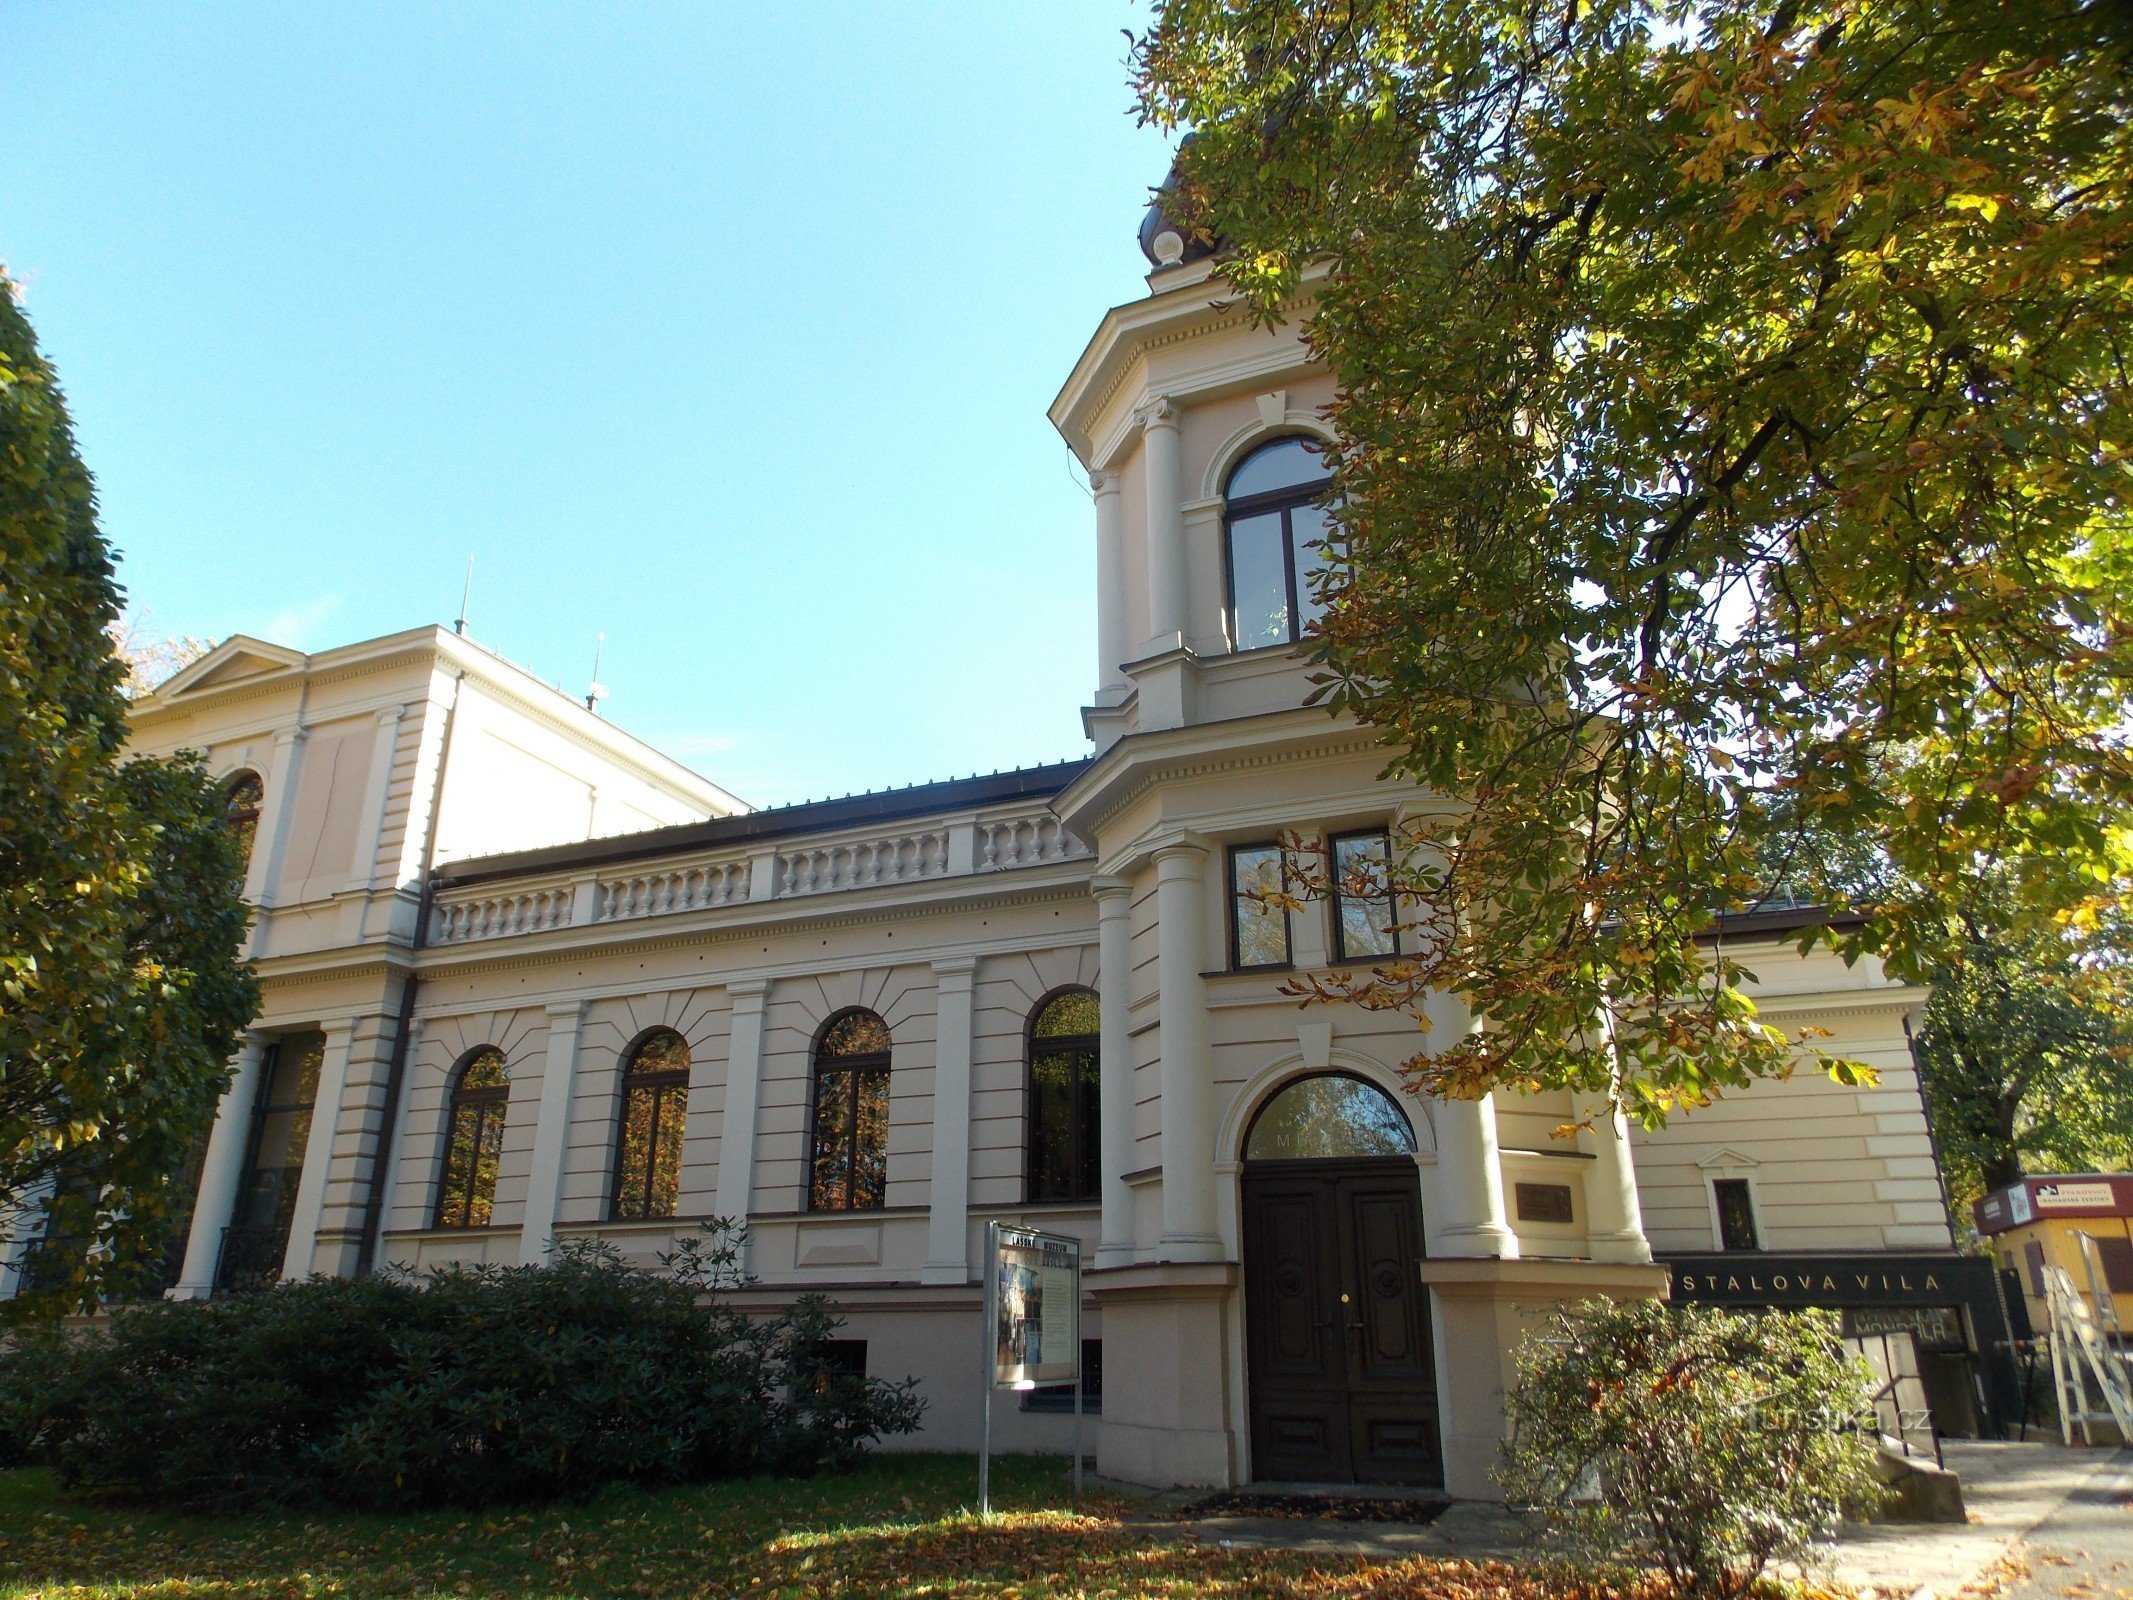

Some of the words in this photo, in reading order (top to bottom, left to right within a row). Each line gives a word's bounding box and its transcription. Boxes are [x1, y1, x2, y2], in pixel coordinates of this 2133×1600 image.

[1276, 1131, 1384, 1149] MUUM
[1043, 1241, 1067, 1253] MUZEUM
[1682, 1275, 1836, 1291] STALOVA
[1856, 1274, 1939, 1290] VILA
